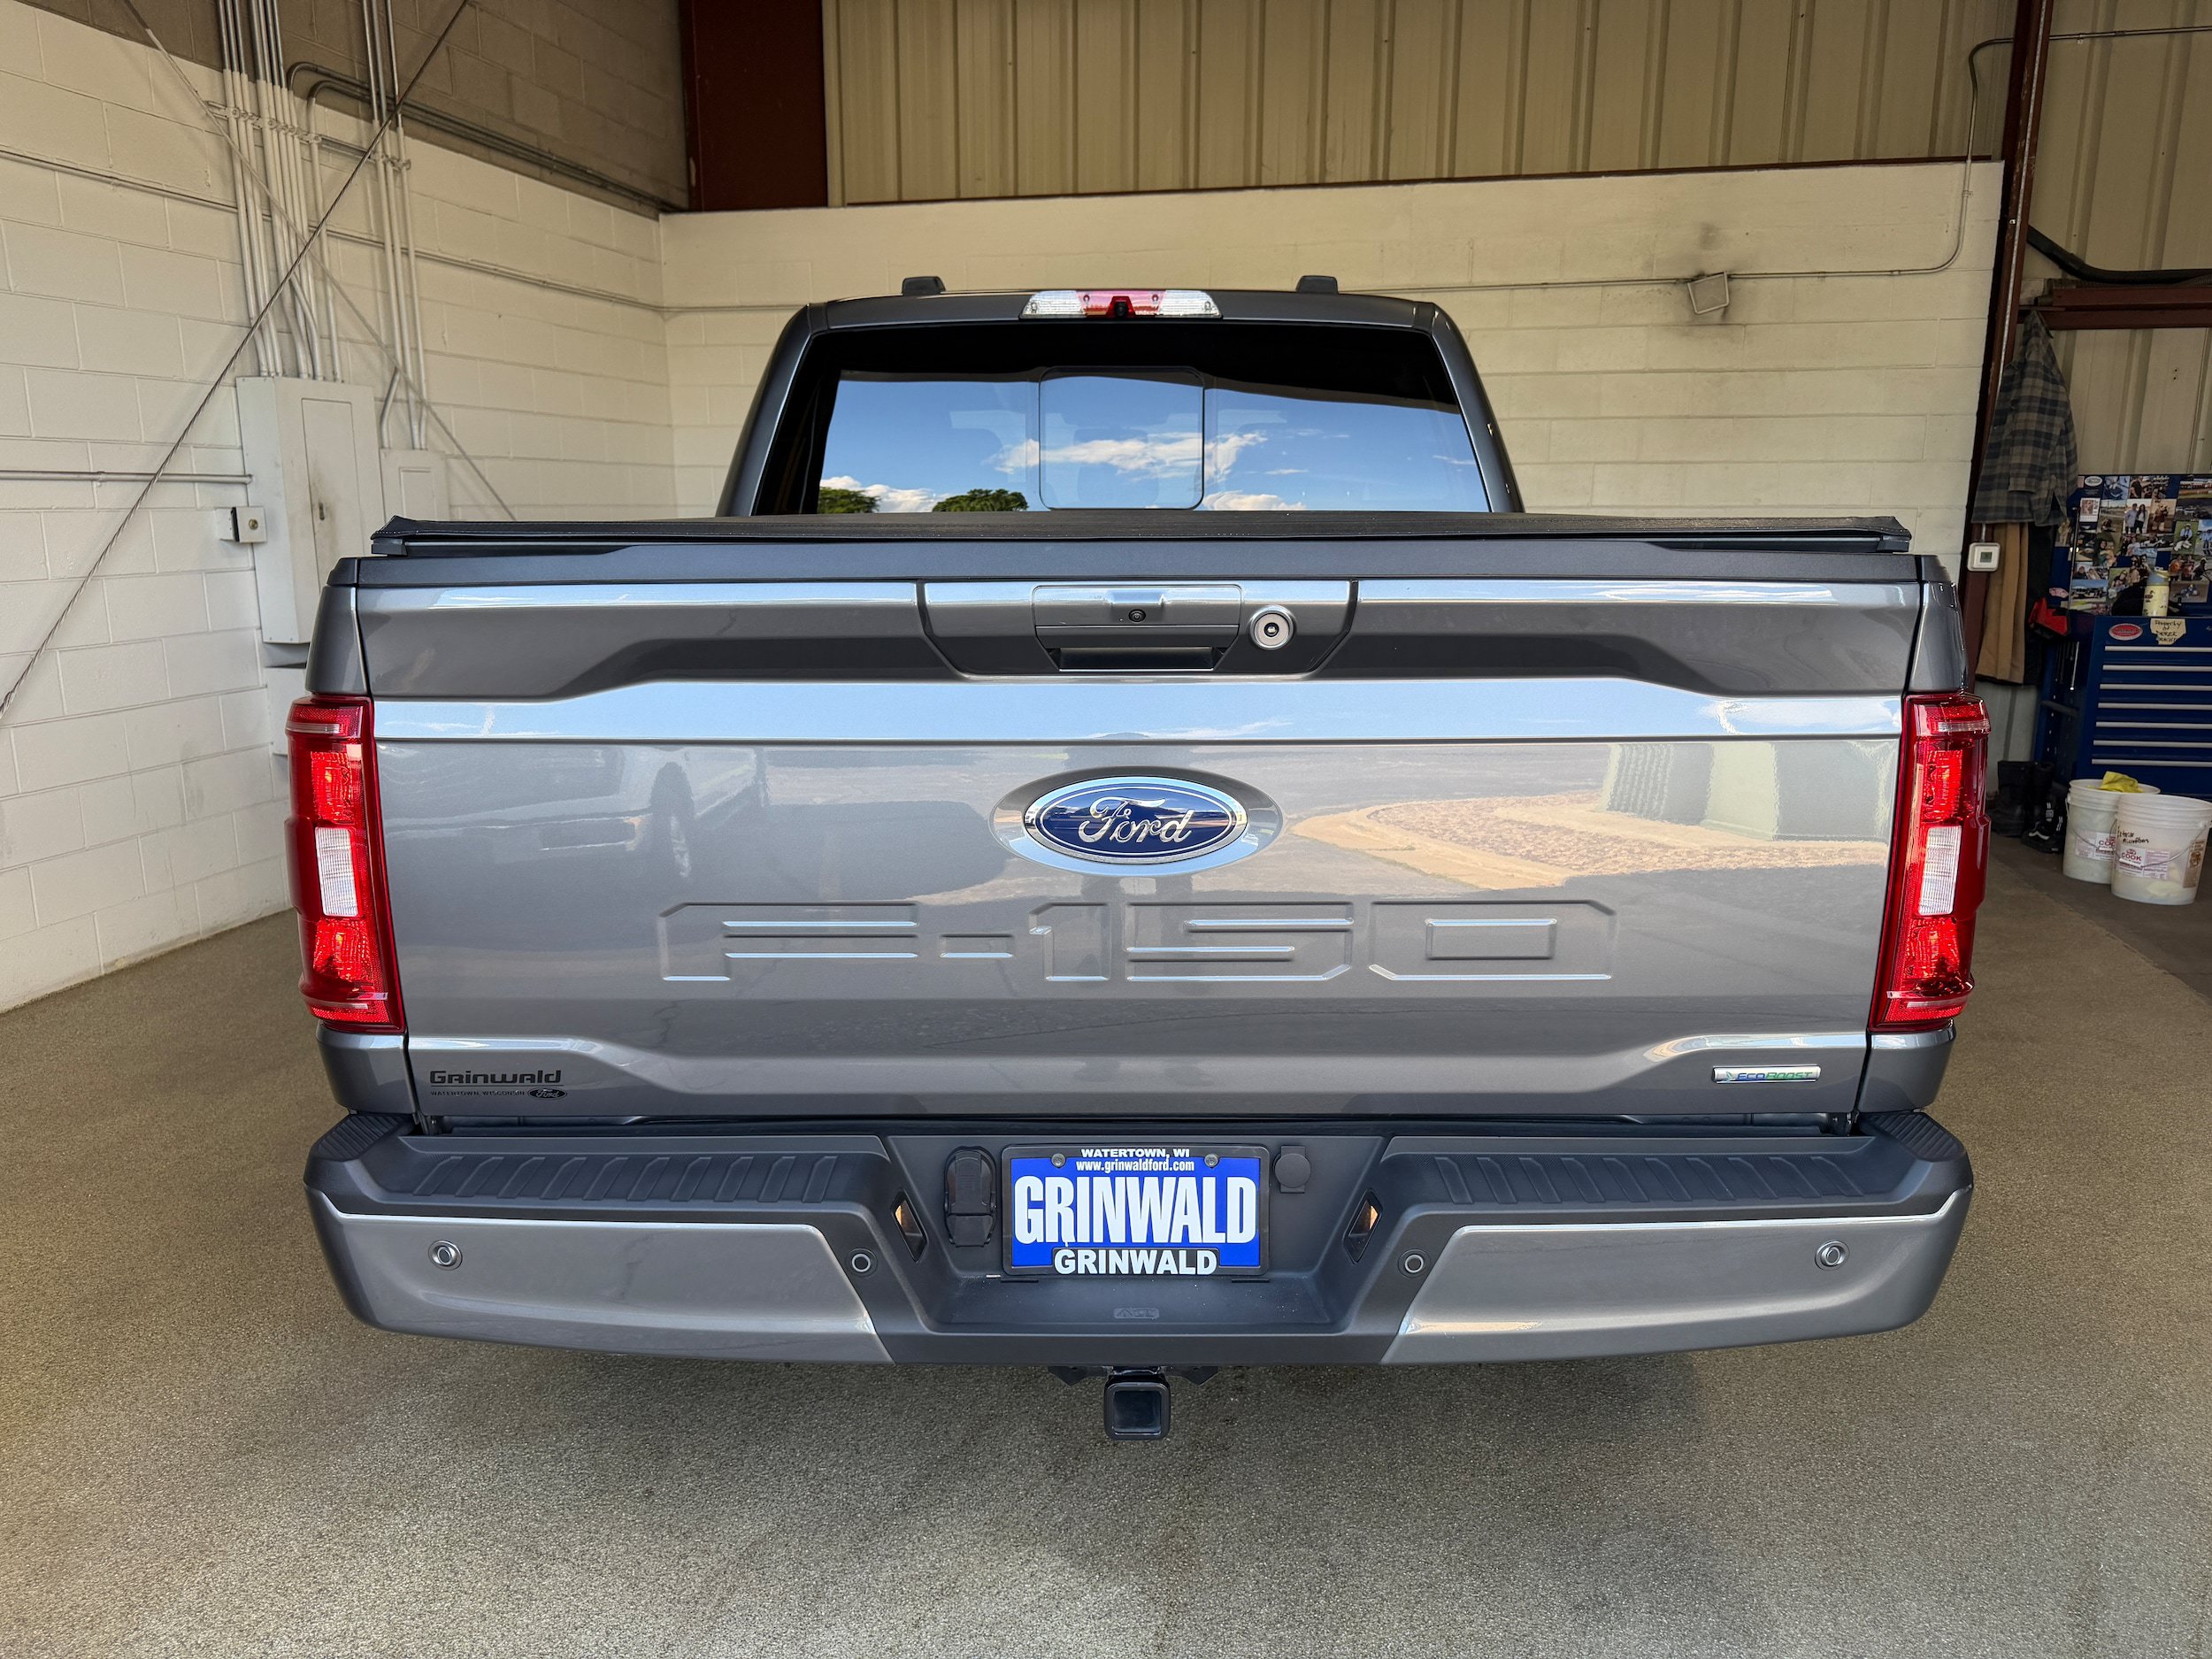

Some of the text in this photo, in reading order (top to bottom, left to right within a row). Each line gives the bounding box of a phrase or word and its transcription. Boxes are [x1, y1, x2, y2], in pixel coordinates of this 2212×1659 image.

[1079, 796, 1194, 843] Ford
[2122, 852, 2141, 861] COOK
[657, 901, 1617, 981] F-150
[535, 1088, 560, 1099] Ford
[1081, 1148, 1190, 1159] WATERTOWN, WI
[1076, 1158, 1194, 1173] www.grinwaldford.com
[1014, 1175, 1256, 1245] GRINWALD
[1054, 1248, 1217, 1275] GRINWALD
